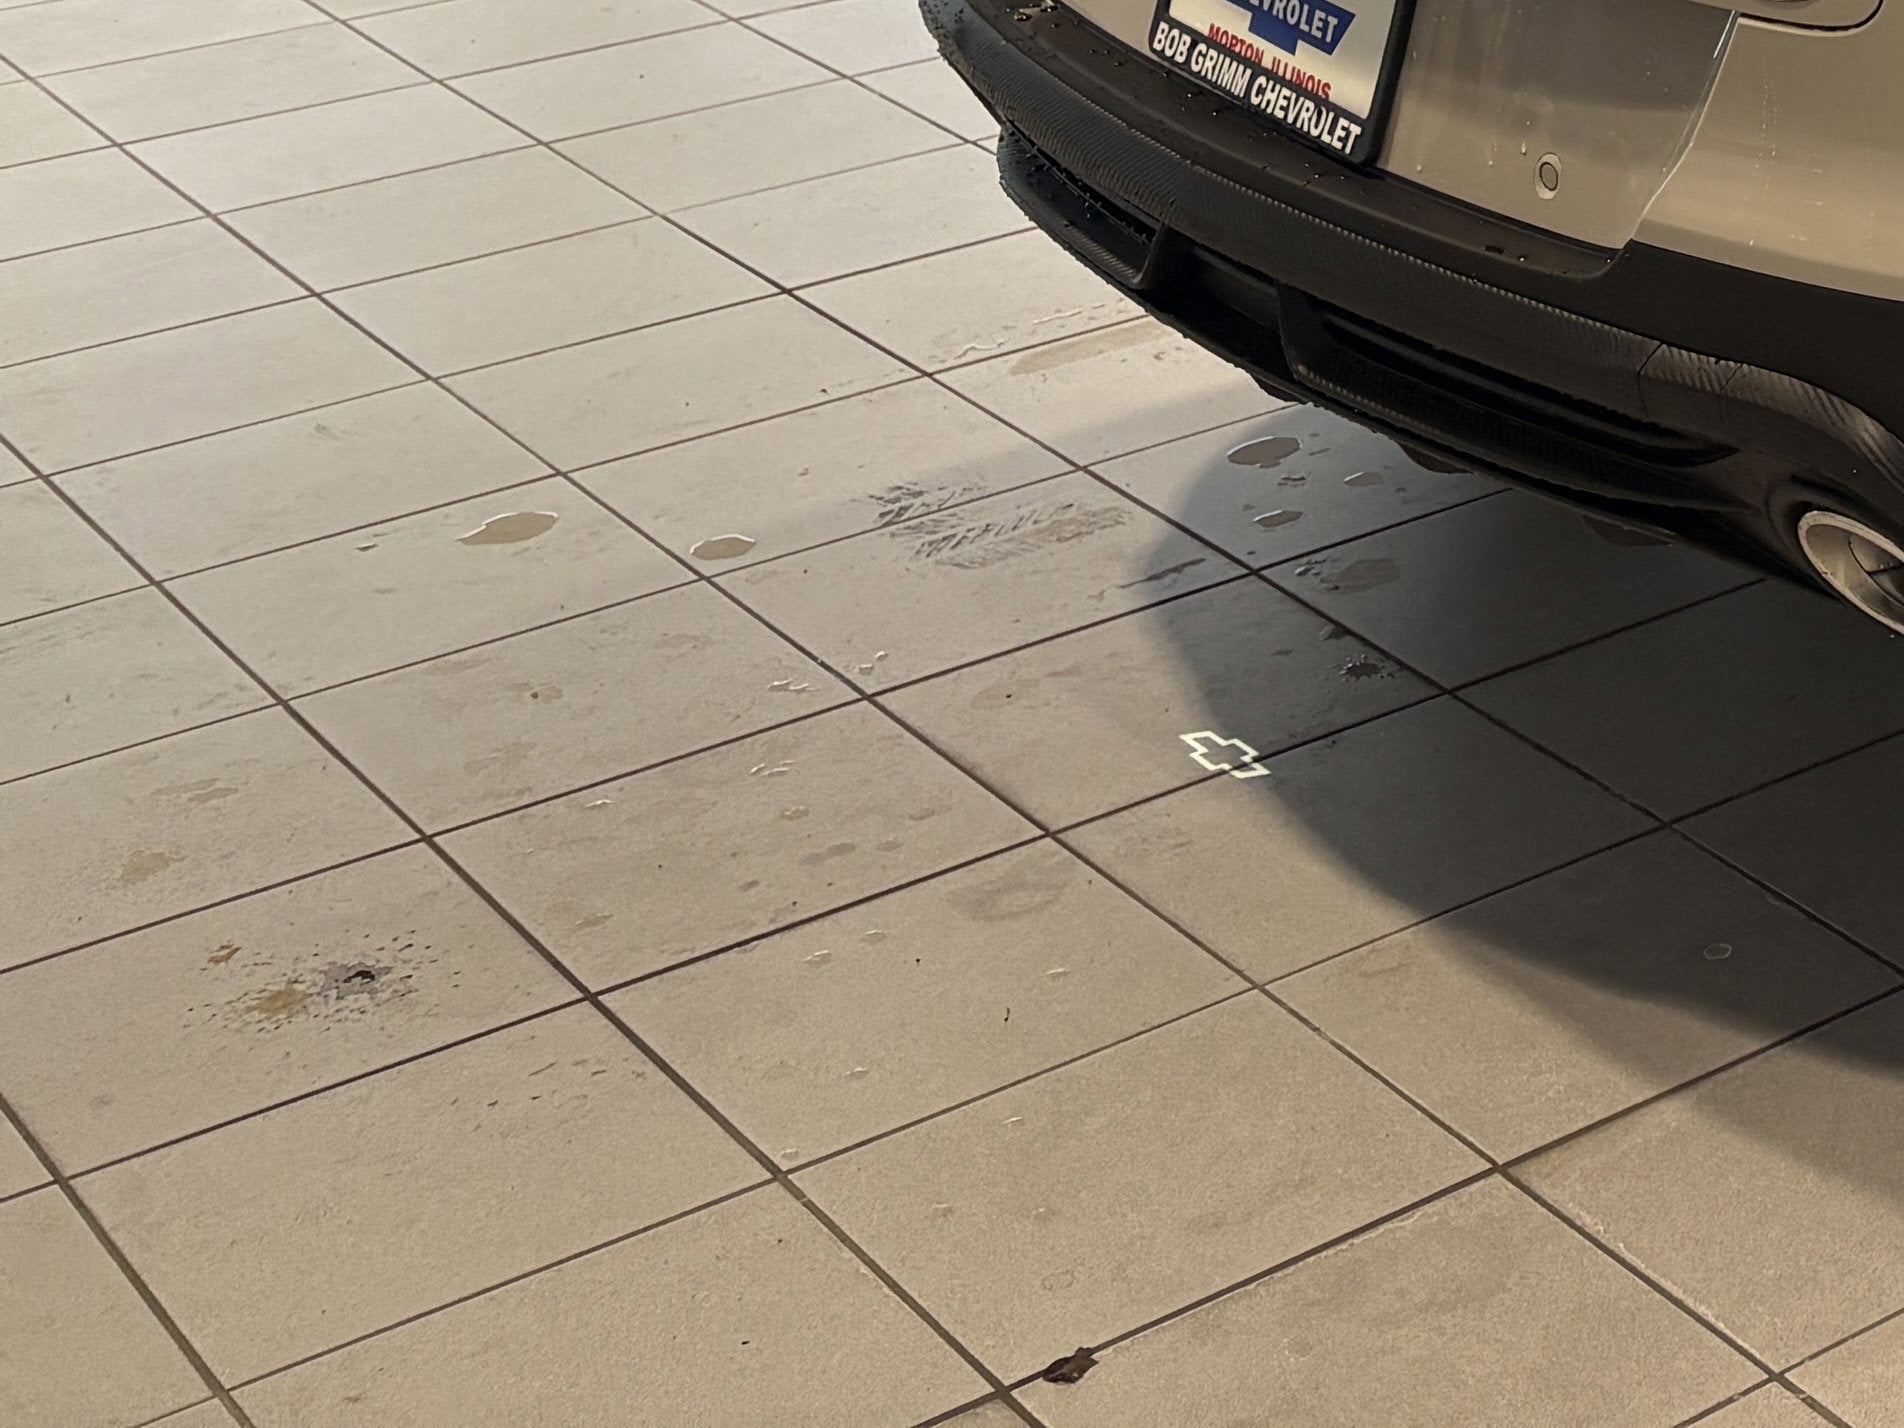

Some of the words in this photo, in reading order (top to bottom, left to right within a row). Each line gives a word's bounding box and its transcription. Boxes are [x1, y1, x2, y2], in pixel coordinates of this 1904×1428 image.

[1153, 21, 1191, 65] BOB
[1190, 43, 1251, 98] GRIMM
[1250, 75, 1363, 156] CHEVROLET
[1208, 22, 1266, 66] MORTON
[1270, 55, 1332, 99] ILLINOIS
